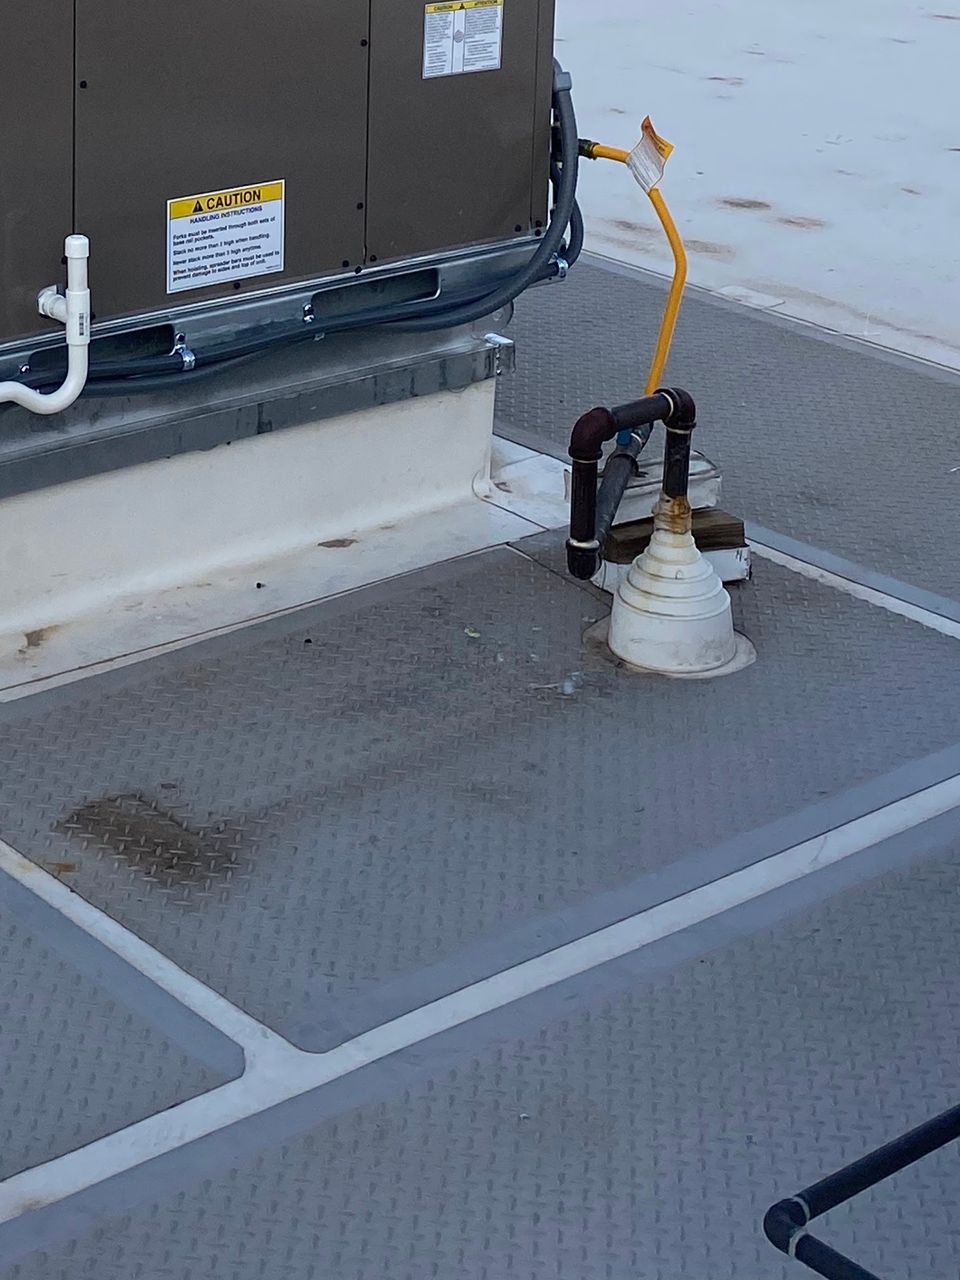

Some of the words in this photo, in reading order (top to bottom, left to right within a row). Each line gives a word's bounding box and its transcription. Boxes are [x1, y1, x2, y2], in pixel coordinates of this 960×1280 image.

[206, 189, 261, 210] CAUTION
[190, 213, 220, 224] HANDLING
[220, 205, 263, 218] INSTRUCTIONS
[208, 225, 228, 233] inserted
[228, 221, 247, 229] through
[173, 273, 191, 282] prevent
[191, 269, 211, 278] damage
[241, 261, 250, 269] top
[209, 260, 230, 269] spreader
